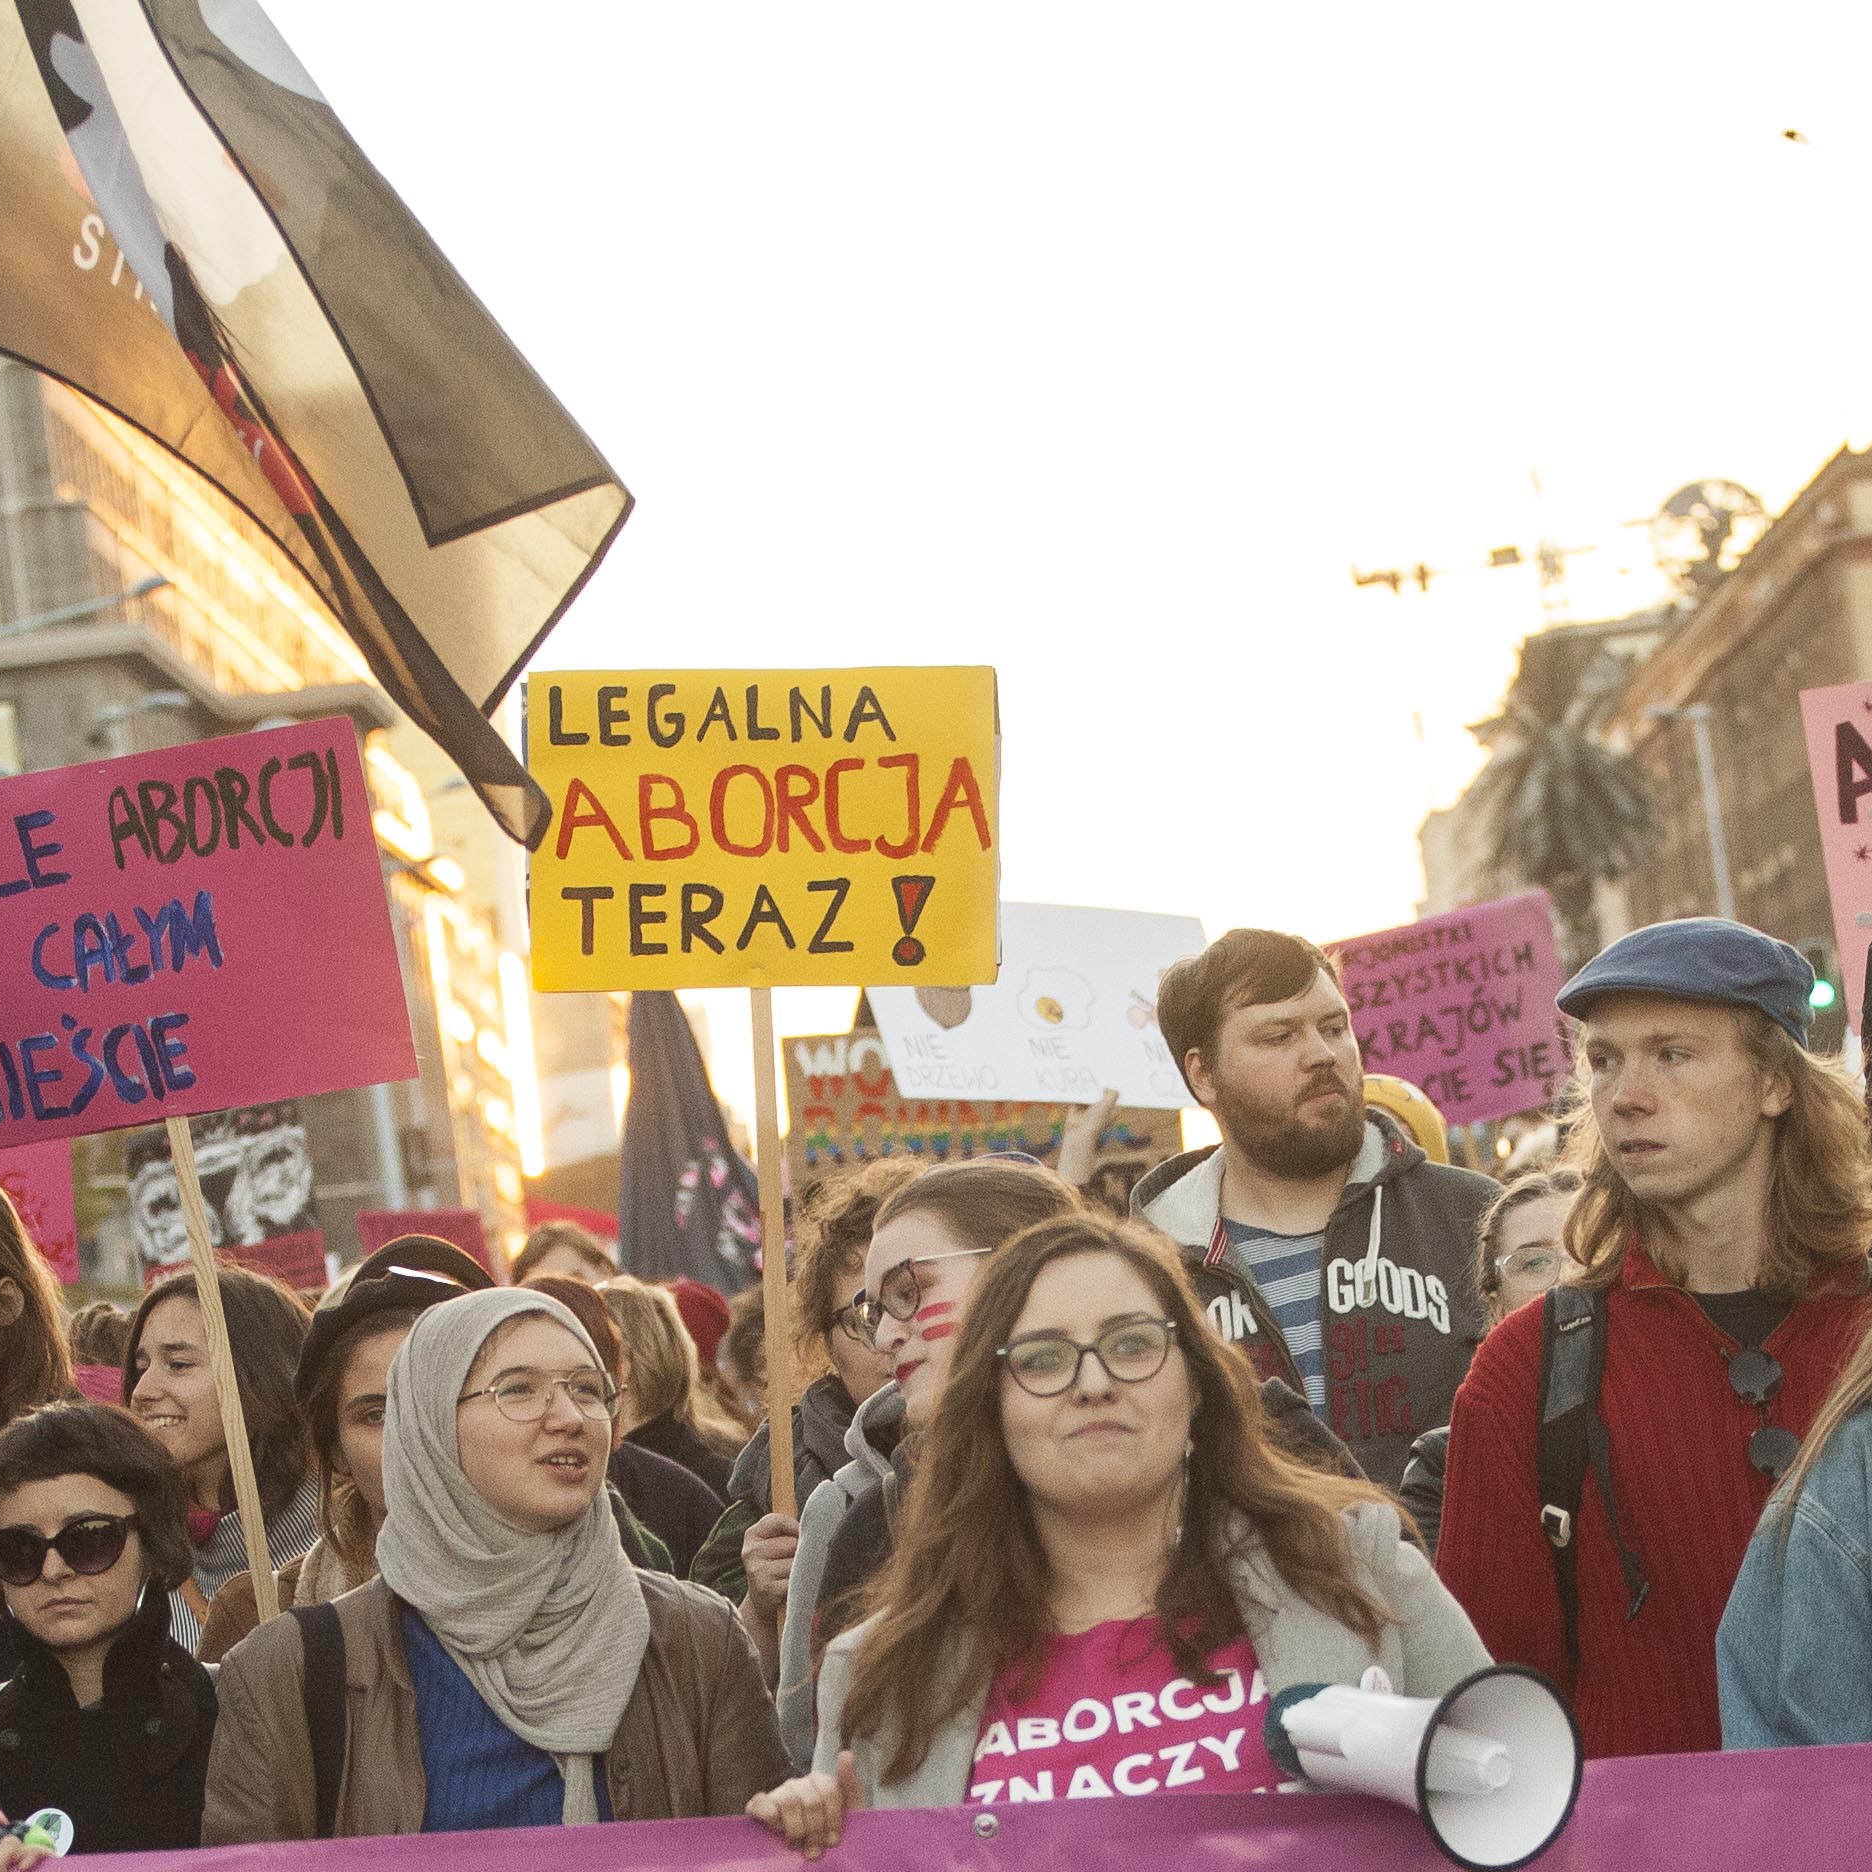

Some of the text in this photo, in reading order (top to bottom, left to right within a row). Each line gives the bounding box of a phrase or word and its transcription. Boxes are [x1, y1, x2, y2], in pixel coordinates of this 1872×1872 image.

[548, 683, 897, 748] LEGALNA
[108, 746, 344, 869] ABORCJI
[555, 752, 992, 861] ABORCJA
[32, 889, 225, 993] CAŁYM
[970, 1726, 1247, 1804] ZNACZY
